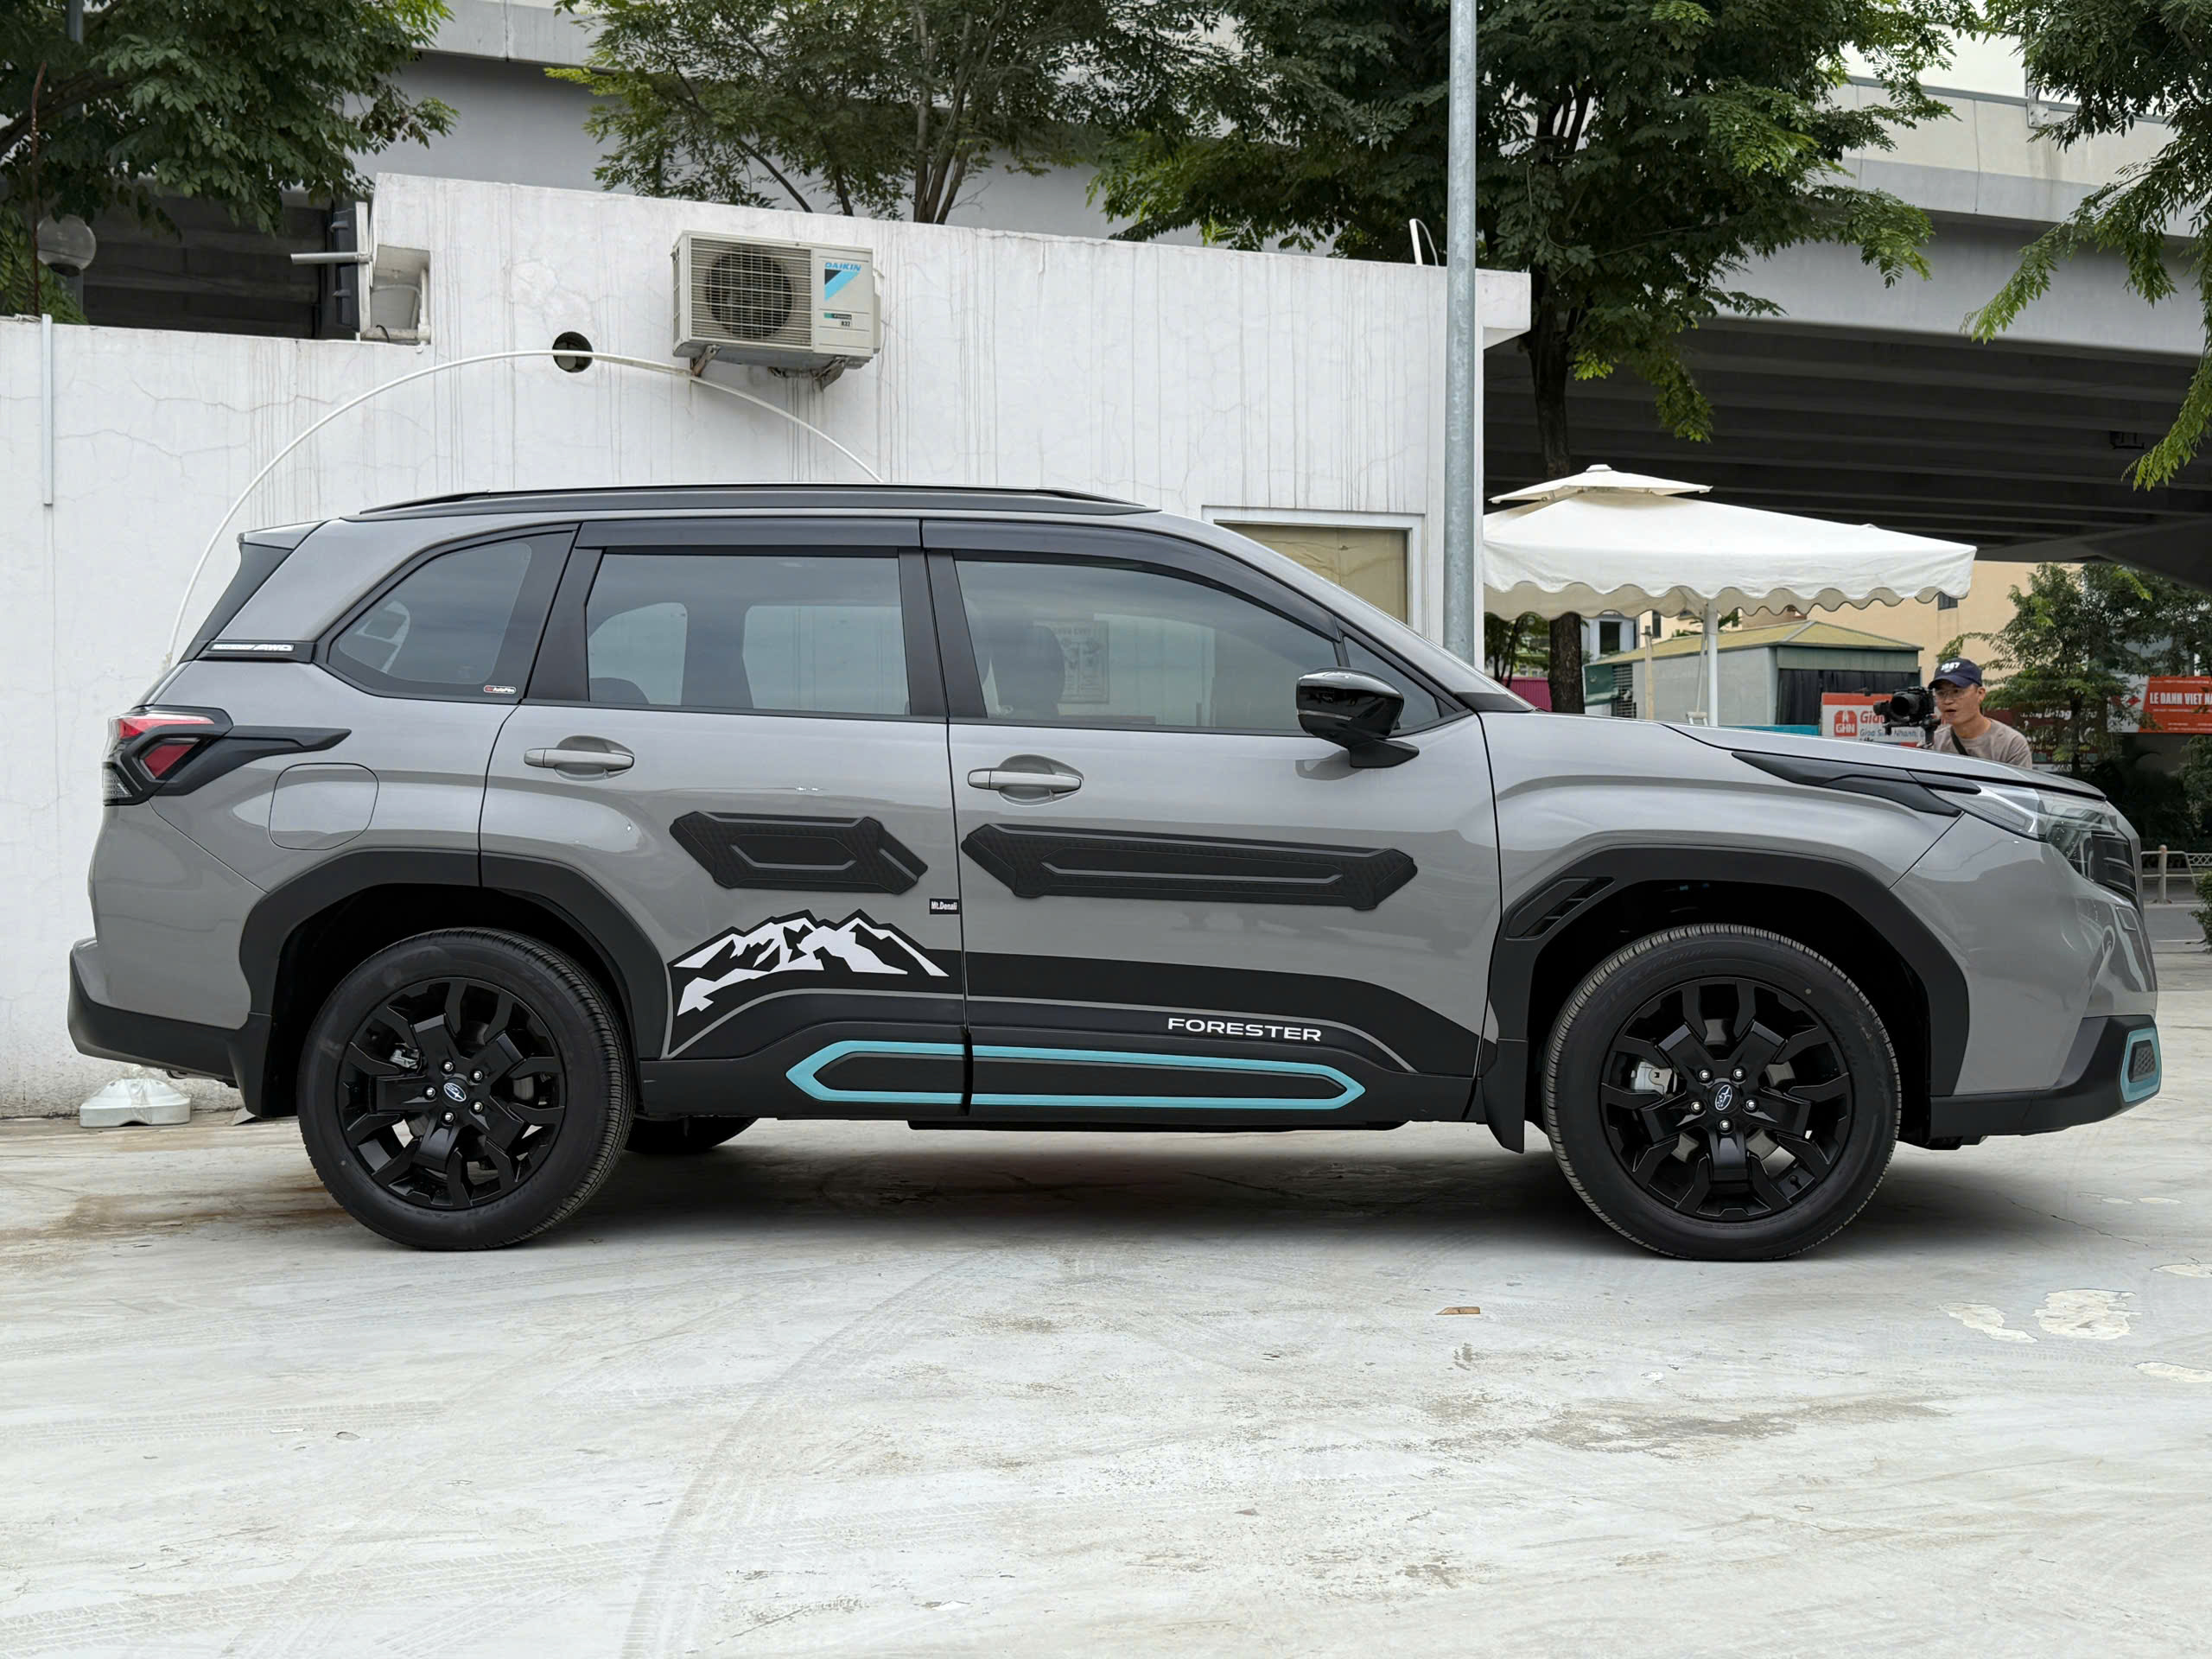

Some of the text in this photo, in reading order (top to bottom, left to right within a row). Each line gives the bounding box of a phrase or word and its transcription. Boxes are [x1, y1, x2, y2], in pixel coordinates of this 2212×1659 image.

[824, 262, 861, 272] DAIKIN
[1835, 723, 1855, 733] GHN
[1167, 1017, 1322, 1042] FORESTER
